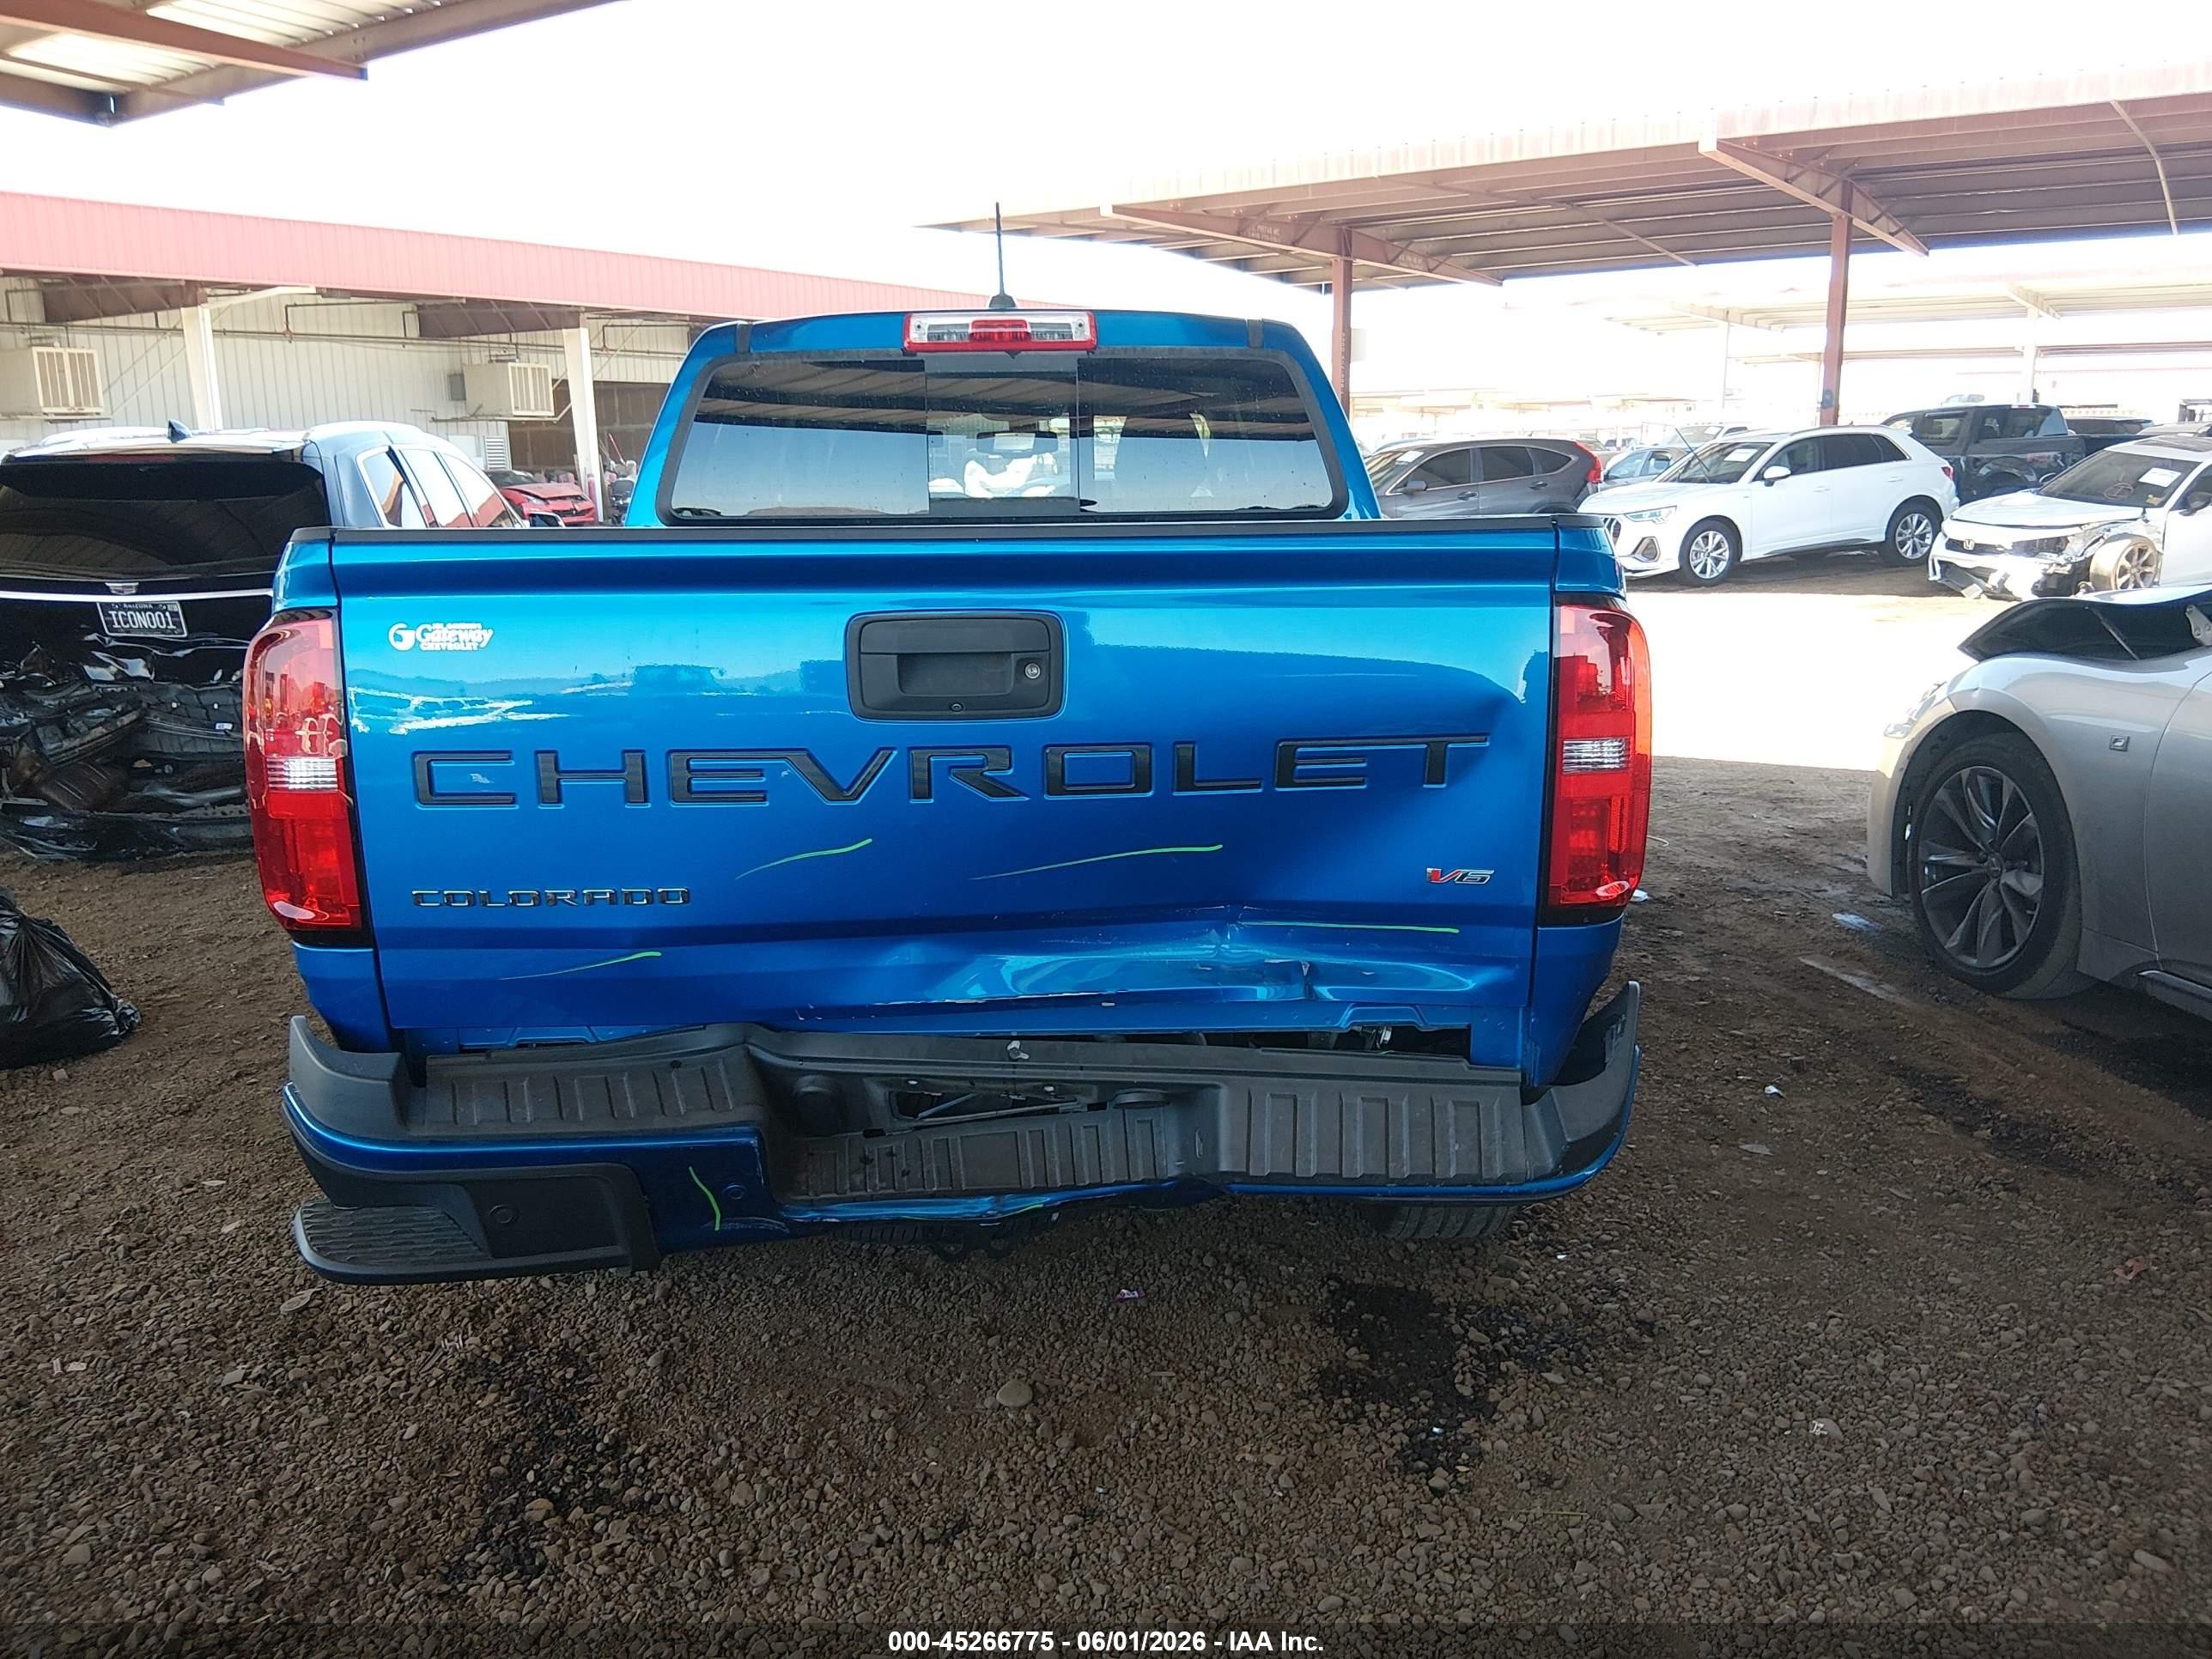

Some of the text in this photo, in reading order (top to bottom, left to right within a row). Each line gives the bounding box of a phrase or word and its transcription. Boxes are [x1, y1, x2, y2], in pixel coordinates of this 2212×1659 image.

[108, 611, 178, 629] ICON001
[416, 623, 494, 647] Gateway
[412, 736, 1489, 809] CHEVROLET
[1425, 867, 1494, 884] V6
[411, 887, 690, 907] COLORADO
